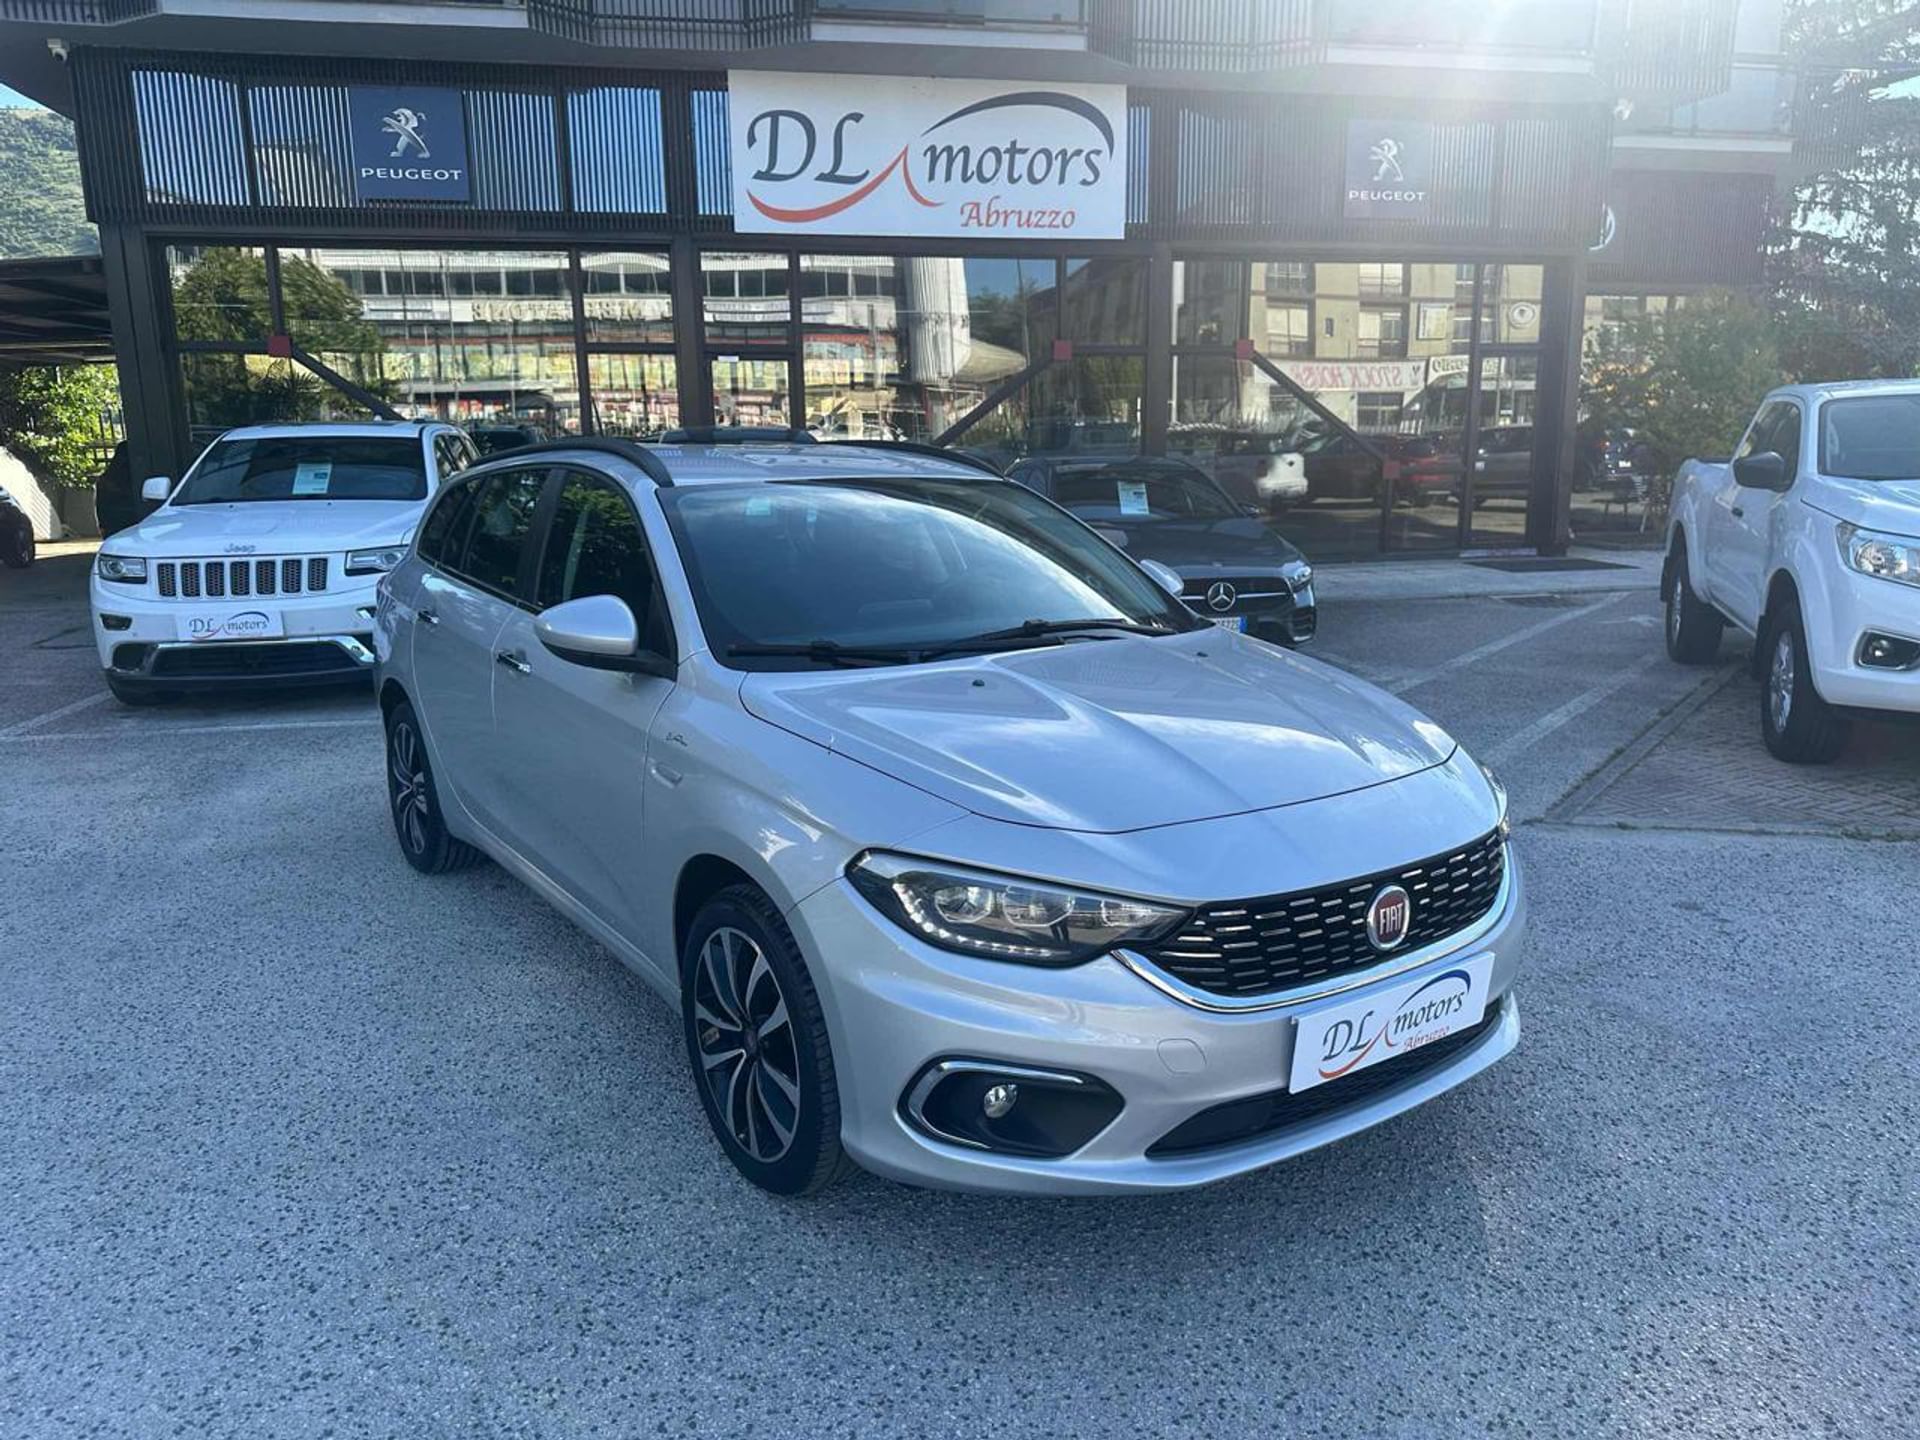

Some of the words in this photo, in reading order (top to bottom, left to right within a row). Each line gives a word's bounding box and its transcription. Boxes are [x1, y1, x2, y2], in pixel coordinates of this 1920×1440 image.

[746, 109, 870, 185] DL
[923, 139, 1104, 186] motors
[360, 167, 463, 181] PEUGEOT
[959, 194, 1077, 229] Abruzzo
[1348, 189, 1426, 202] PEUGEOT
[227, 619, 268, 632] motors
[1379, 902, 1404, 936] FIAT
[1321, 1010, 1375, 1062] DL
[1393, 990, 1466, 1036] motors
